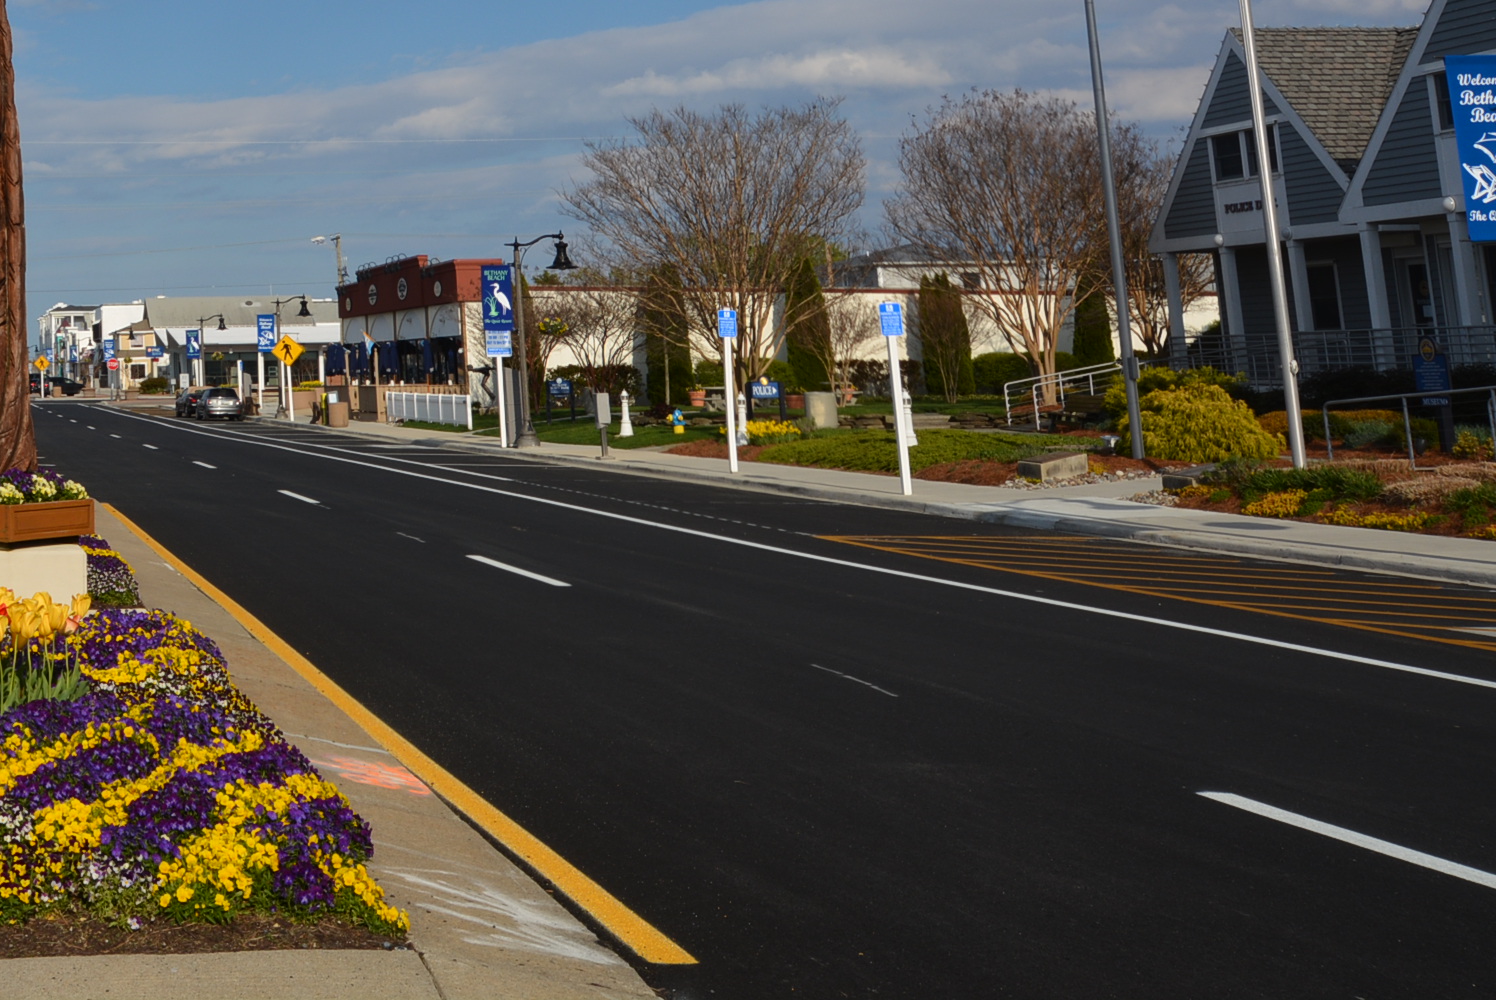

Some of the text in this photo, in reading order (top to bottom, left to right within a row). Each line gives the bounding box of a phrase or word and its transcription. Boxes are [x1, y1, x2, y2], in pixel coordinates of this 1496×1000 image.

[1459, 89, 1496, 106] Beth
[1224, 201, 1254, 214] POLICE
[1469, 210, 1488, 222] The
[752, 386, 772, 396] POLICE
